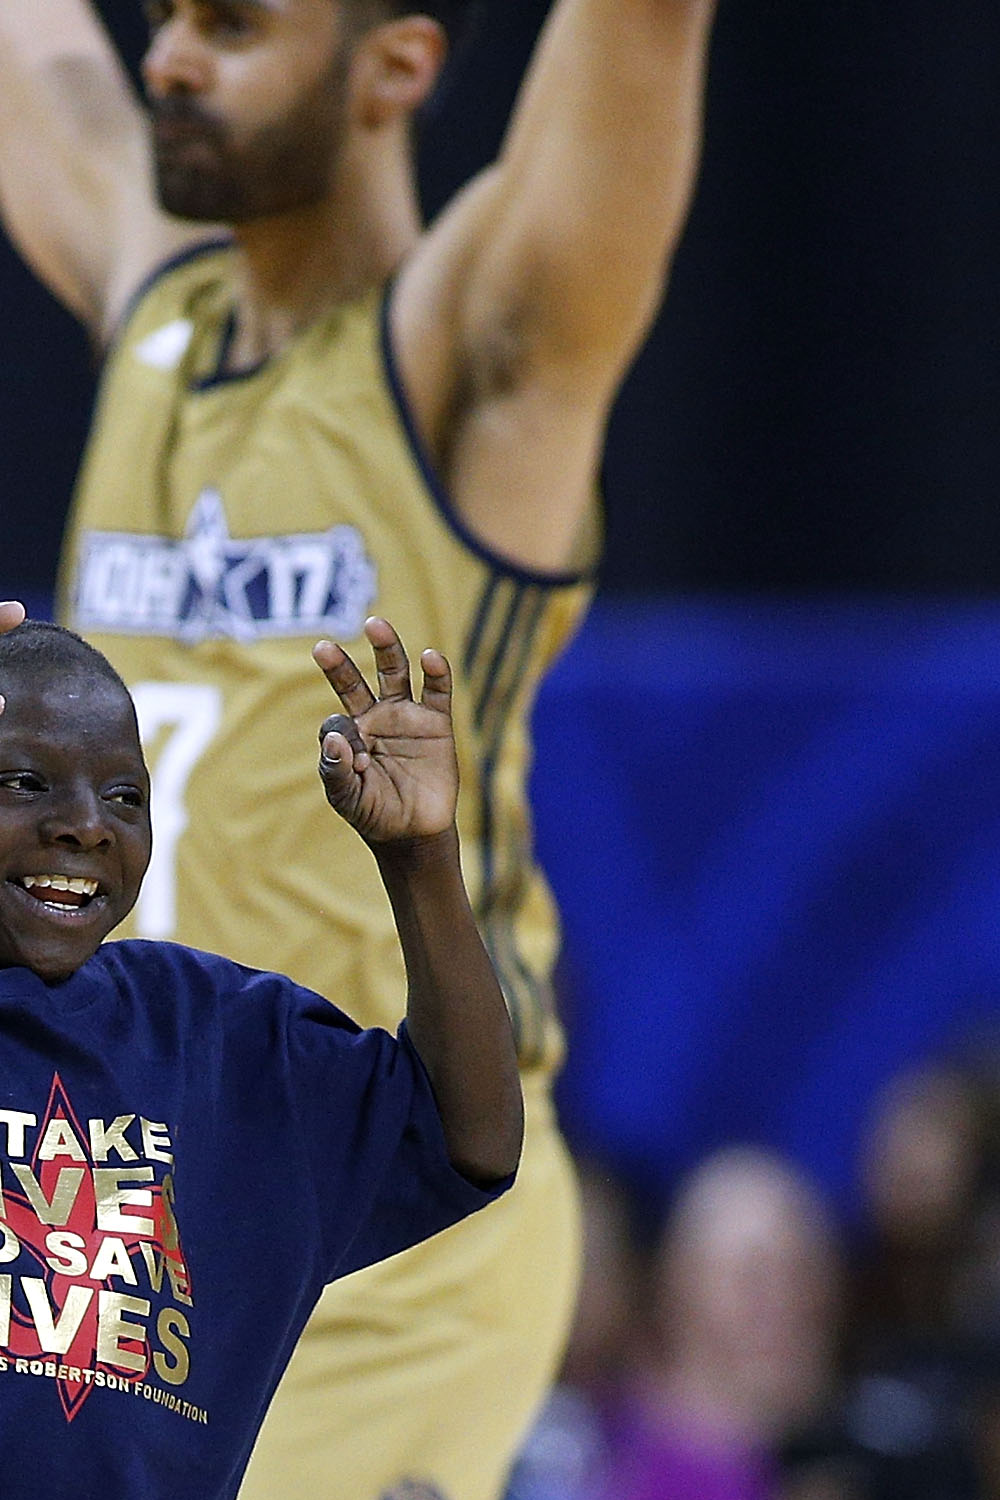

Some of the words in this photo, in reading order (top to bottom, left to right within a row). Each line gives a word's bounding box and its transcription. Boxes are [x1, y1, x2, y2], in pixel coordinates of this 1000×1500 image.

[45, 1230, 195, 1308] SAVE
[14, 1357, 131, 1393] ROBERTSON
[133, 1381, 208, 1425] FOUNDATION
